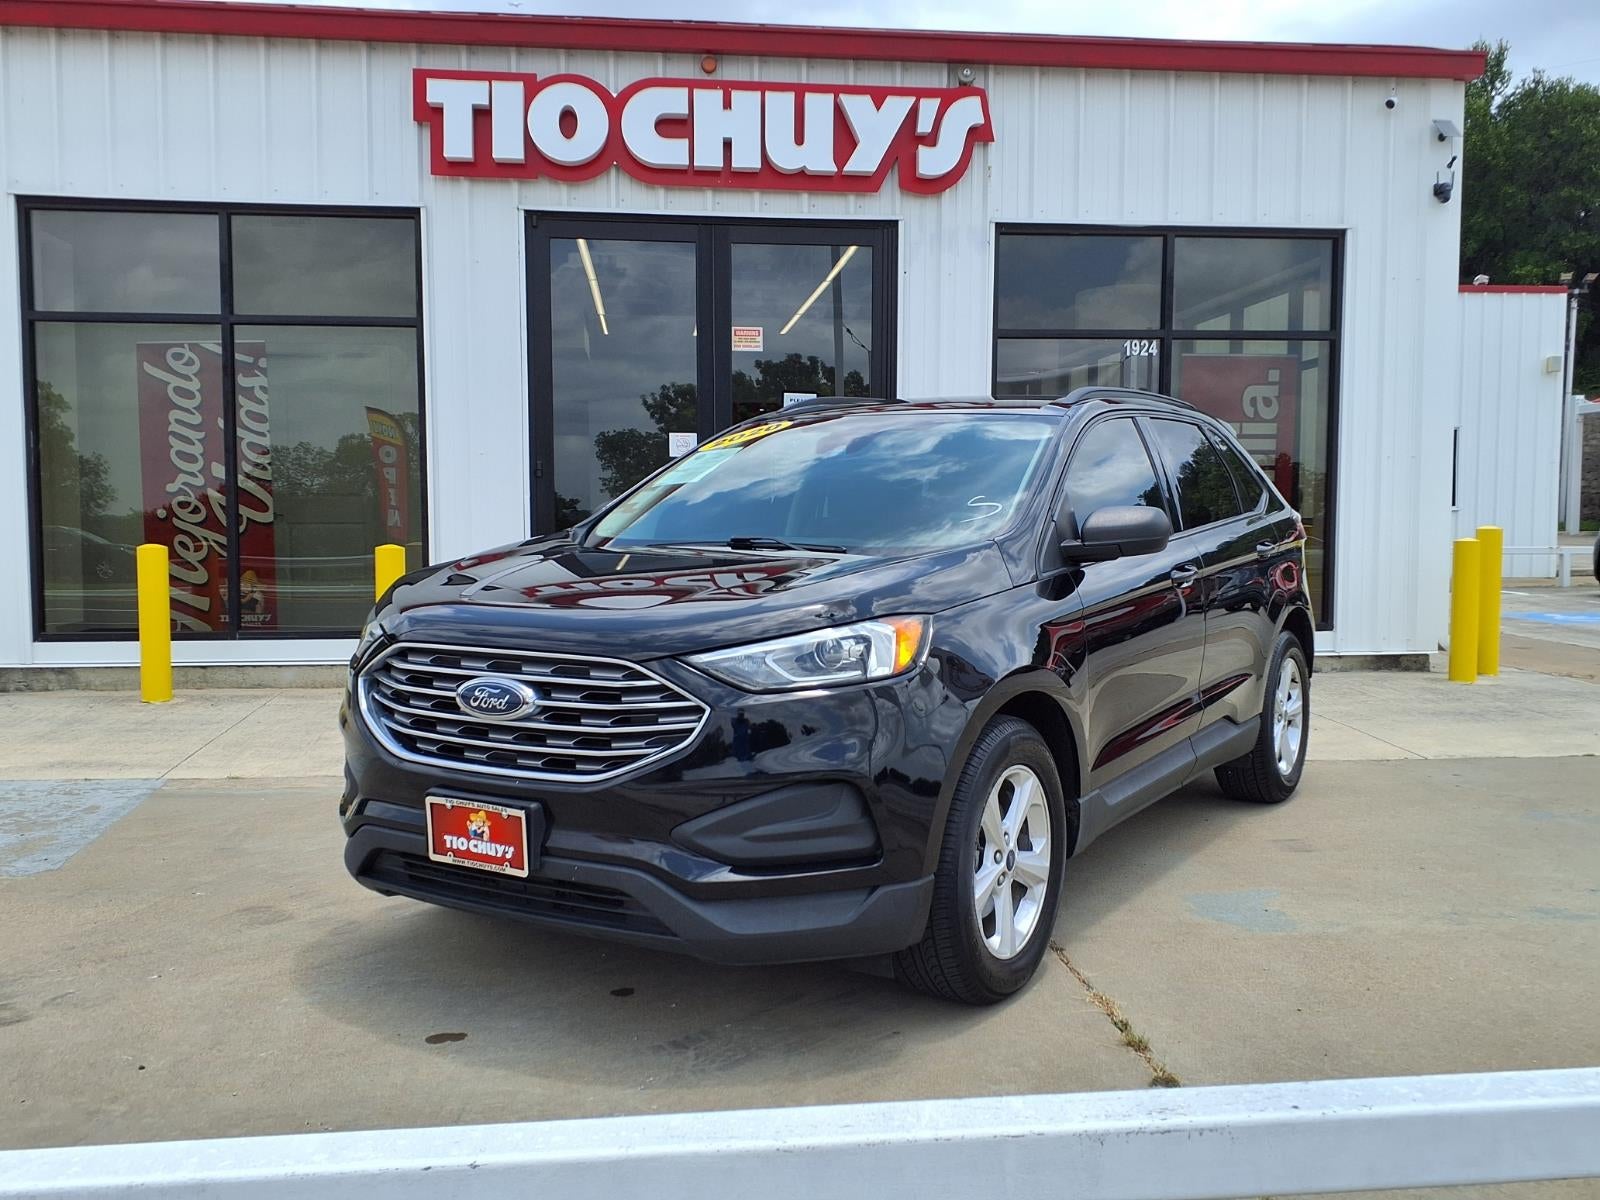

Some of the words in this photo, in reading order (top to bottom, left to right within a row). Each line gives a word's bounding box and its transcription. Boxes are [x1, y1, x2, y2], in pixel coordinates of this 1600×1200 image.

[426, 78, 609, 167] TIO
[621, 86, 985, 180] CHUY'S
[1123, 339, 1158, 357] 1924
[709, 422, 784, 448] 2020
[469, 686, 511, 710] Ford
[443, 834, 468, 851] TIO
[468, 839, 515, 859] CHUY'S
